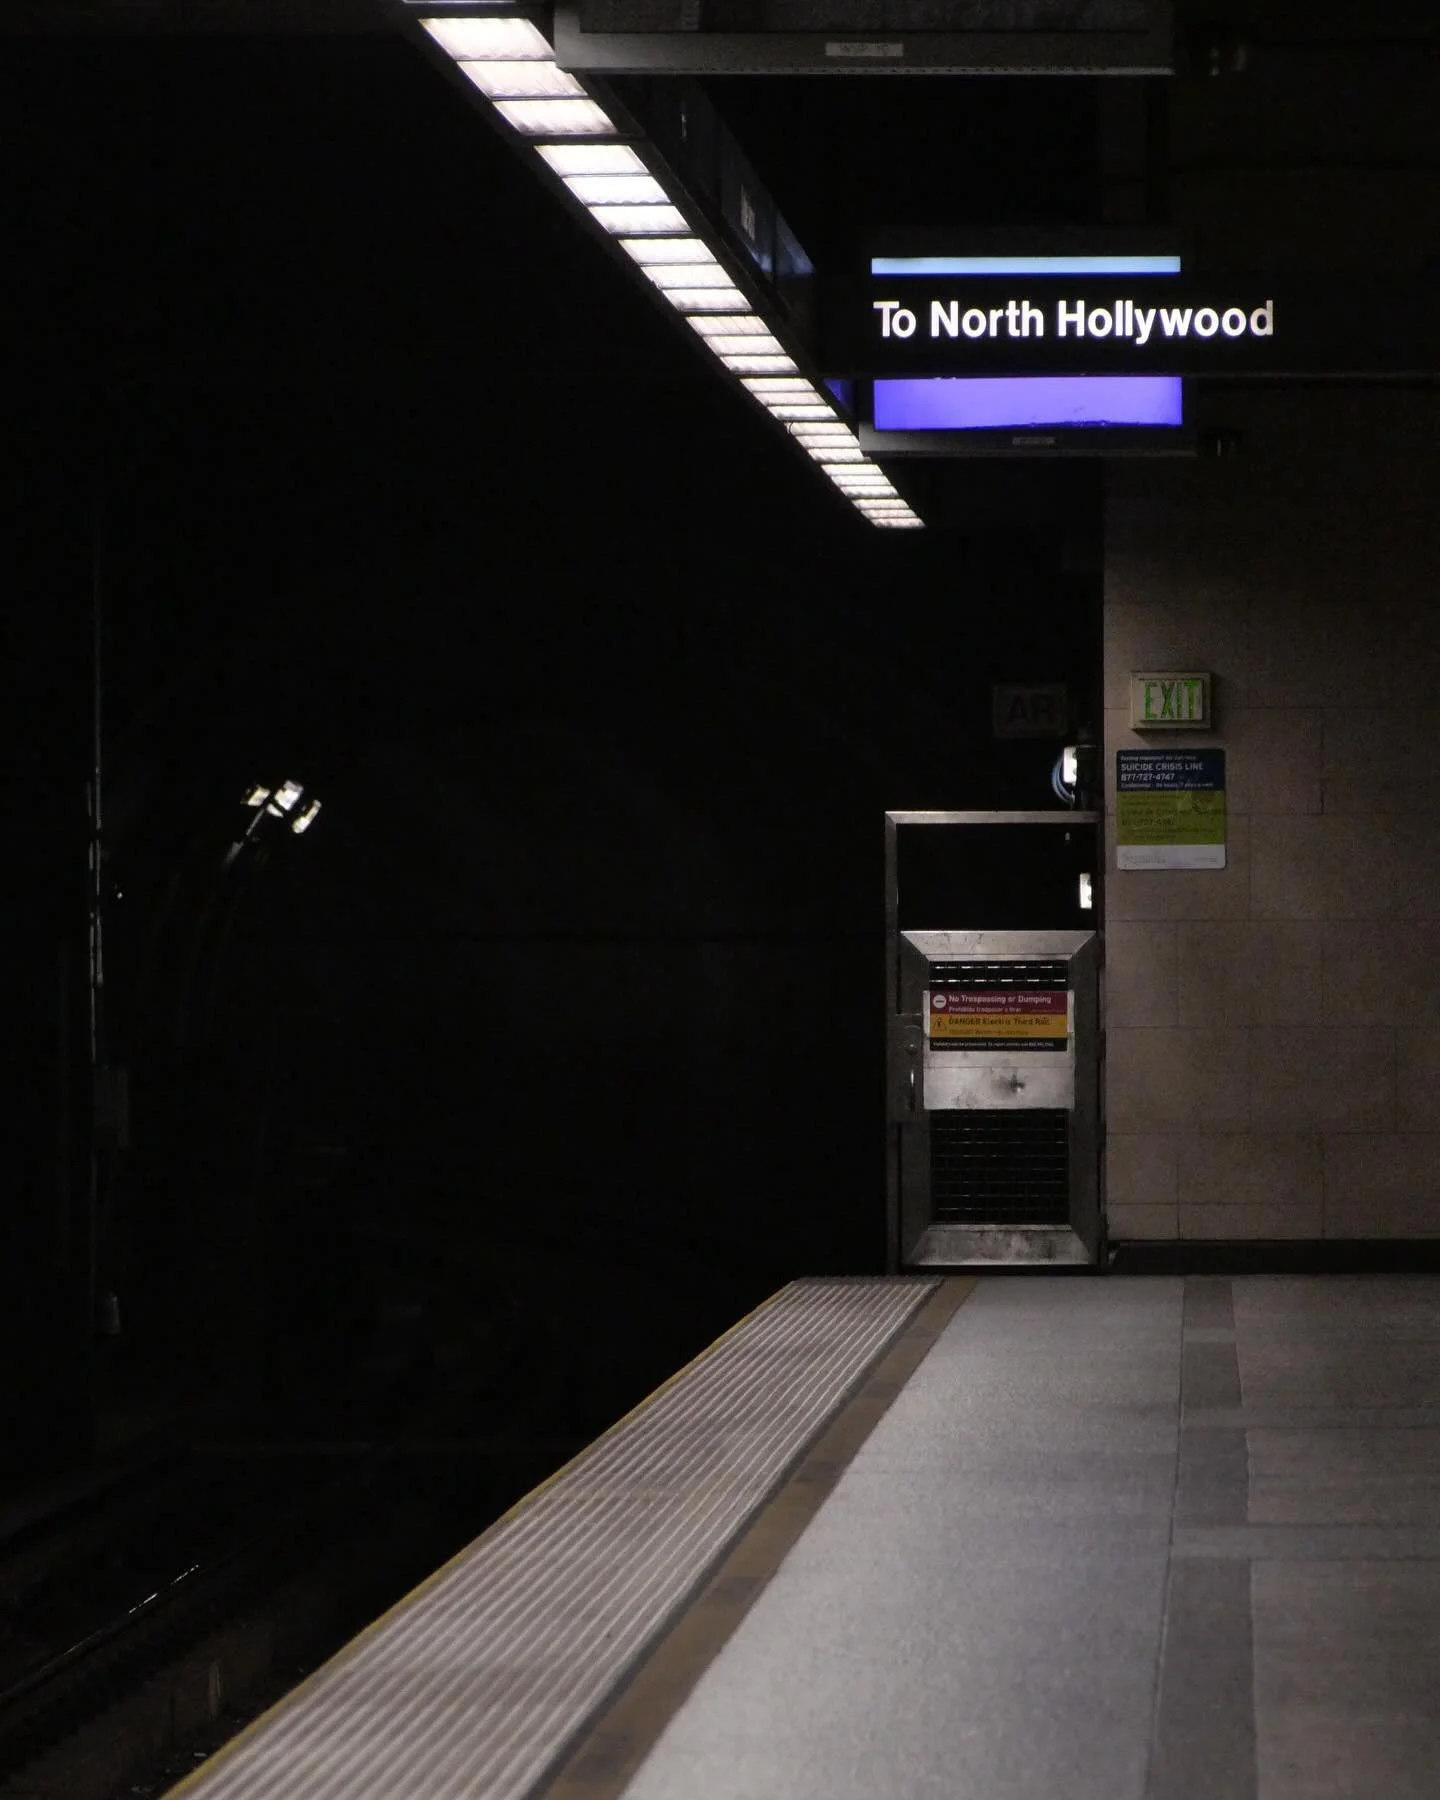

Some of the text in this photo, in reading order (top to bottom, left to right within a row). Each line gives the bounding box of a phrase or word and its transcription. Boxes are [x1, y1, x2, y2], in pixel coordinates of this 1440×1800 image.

[873, 300, 1274, 344] To North Hollywood
[1007, 694, 1057, 724] AR
[1144, 680, 1199, 720] EXIT
[1121, 762, 1205, 771] SUICIDE CRISIS LINE
[948, 995, 960, 1003] No
[961, 995, 1007, 1004] Trespassing
[1018, 995, 1051, 1004] Dumping
[948, 1017, 981, 1025] DANGER
